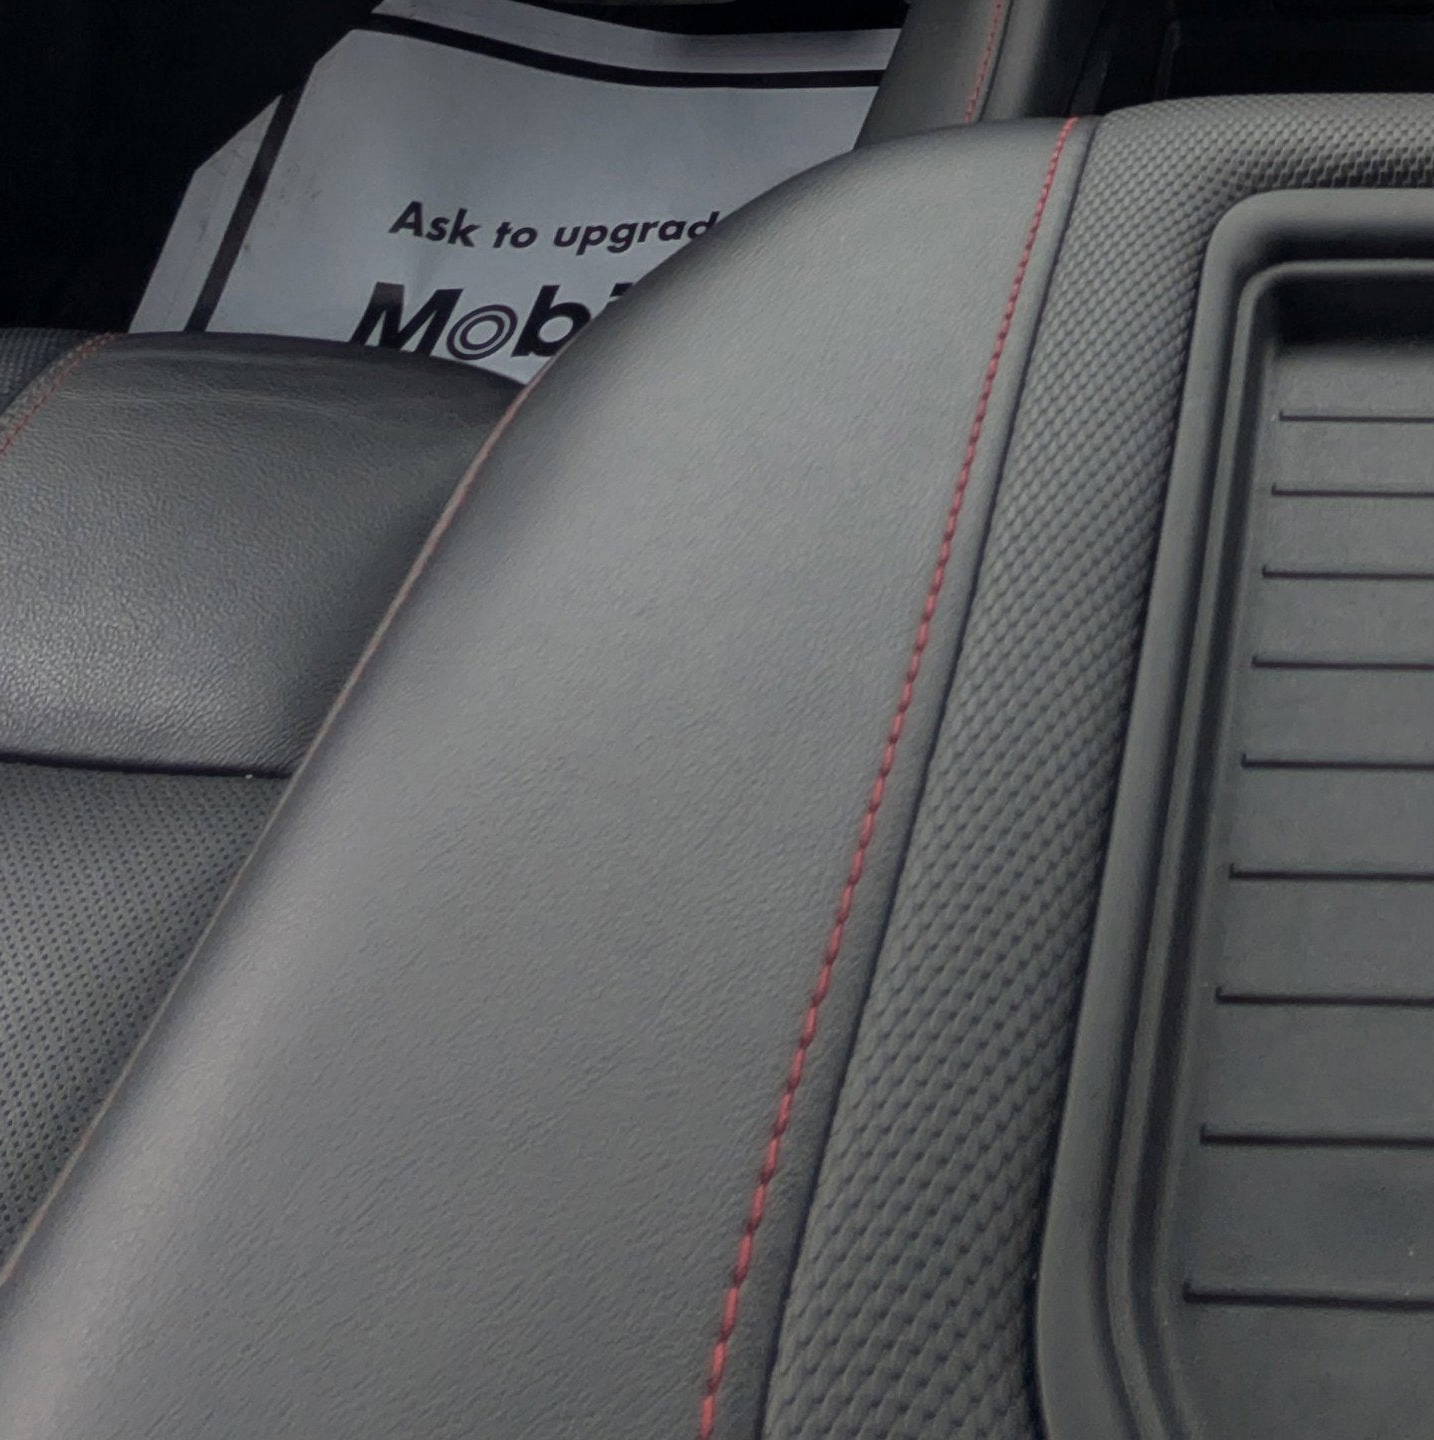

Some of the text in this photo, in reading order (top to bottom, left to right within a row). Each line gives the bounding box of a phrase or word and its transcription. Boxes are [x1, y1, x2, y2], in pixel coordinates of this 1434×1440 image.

[388, 201, 721, 257] Ask to upgrad
